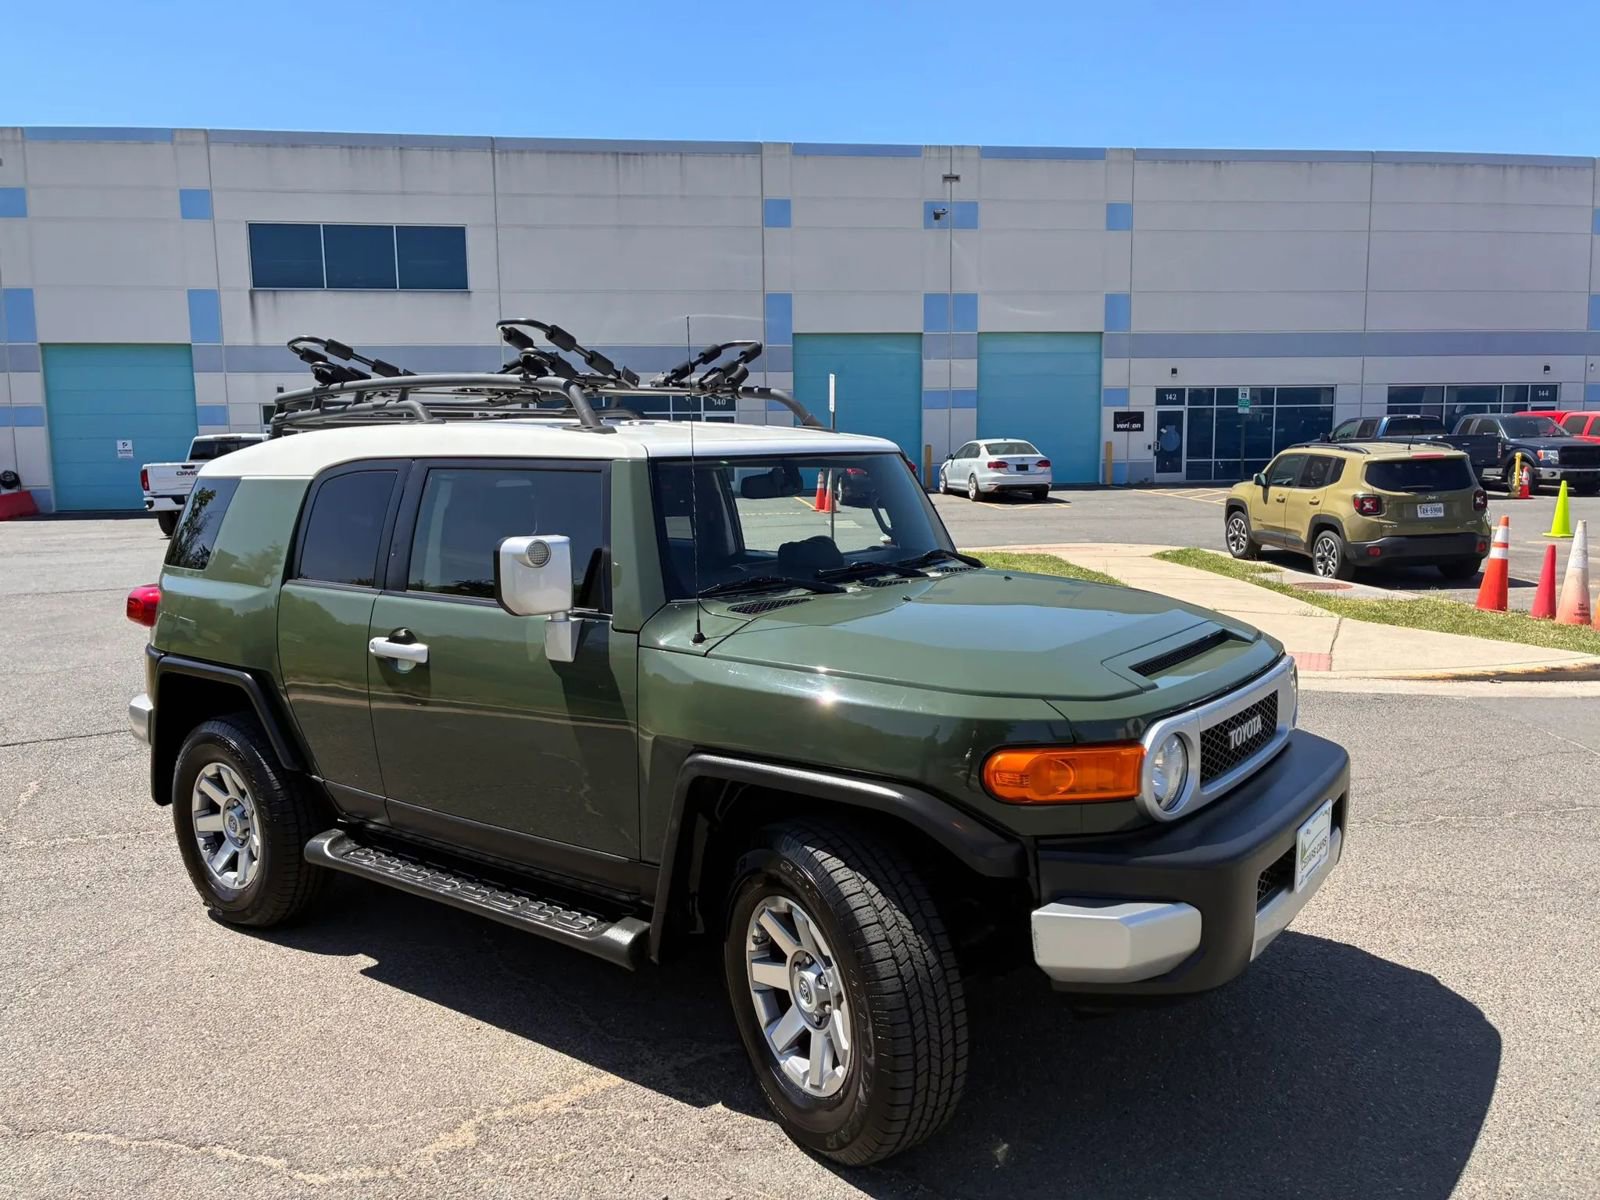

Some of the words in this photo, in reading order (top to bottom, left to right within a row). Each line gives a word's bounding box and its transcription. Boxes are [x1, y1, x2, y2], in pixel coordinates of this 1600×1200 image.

[1165, 393, 1177, 401] 142
[714, 398, 727, 406] 140
[1116, 421, 1141, 430] verion
[1228, 714, 1262, 750] TOYOTA
